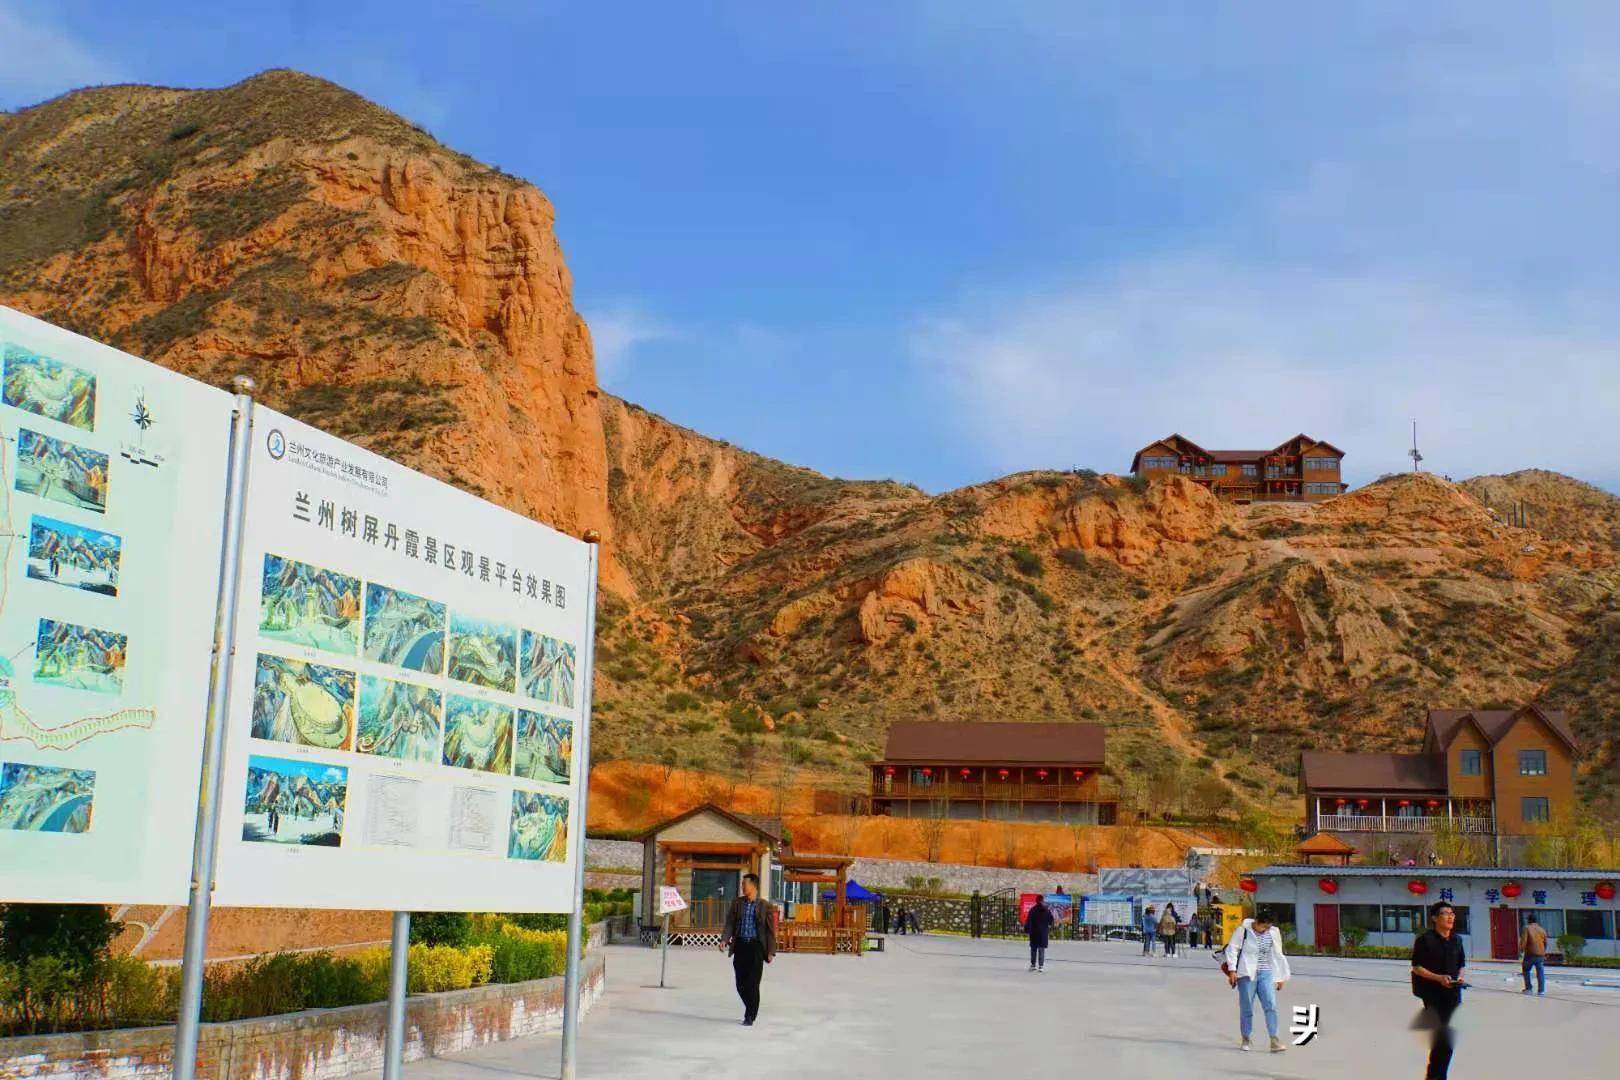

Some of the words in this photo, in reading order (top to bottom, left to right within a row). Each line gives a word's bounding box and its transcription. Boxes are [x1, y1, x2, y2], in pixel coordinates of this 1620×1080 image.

[293, 491, 566, 609] 兰州树屏丹霞景区观景平台效果图
